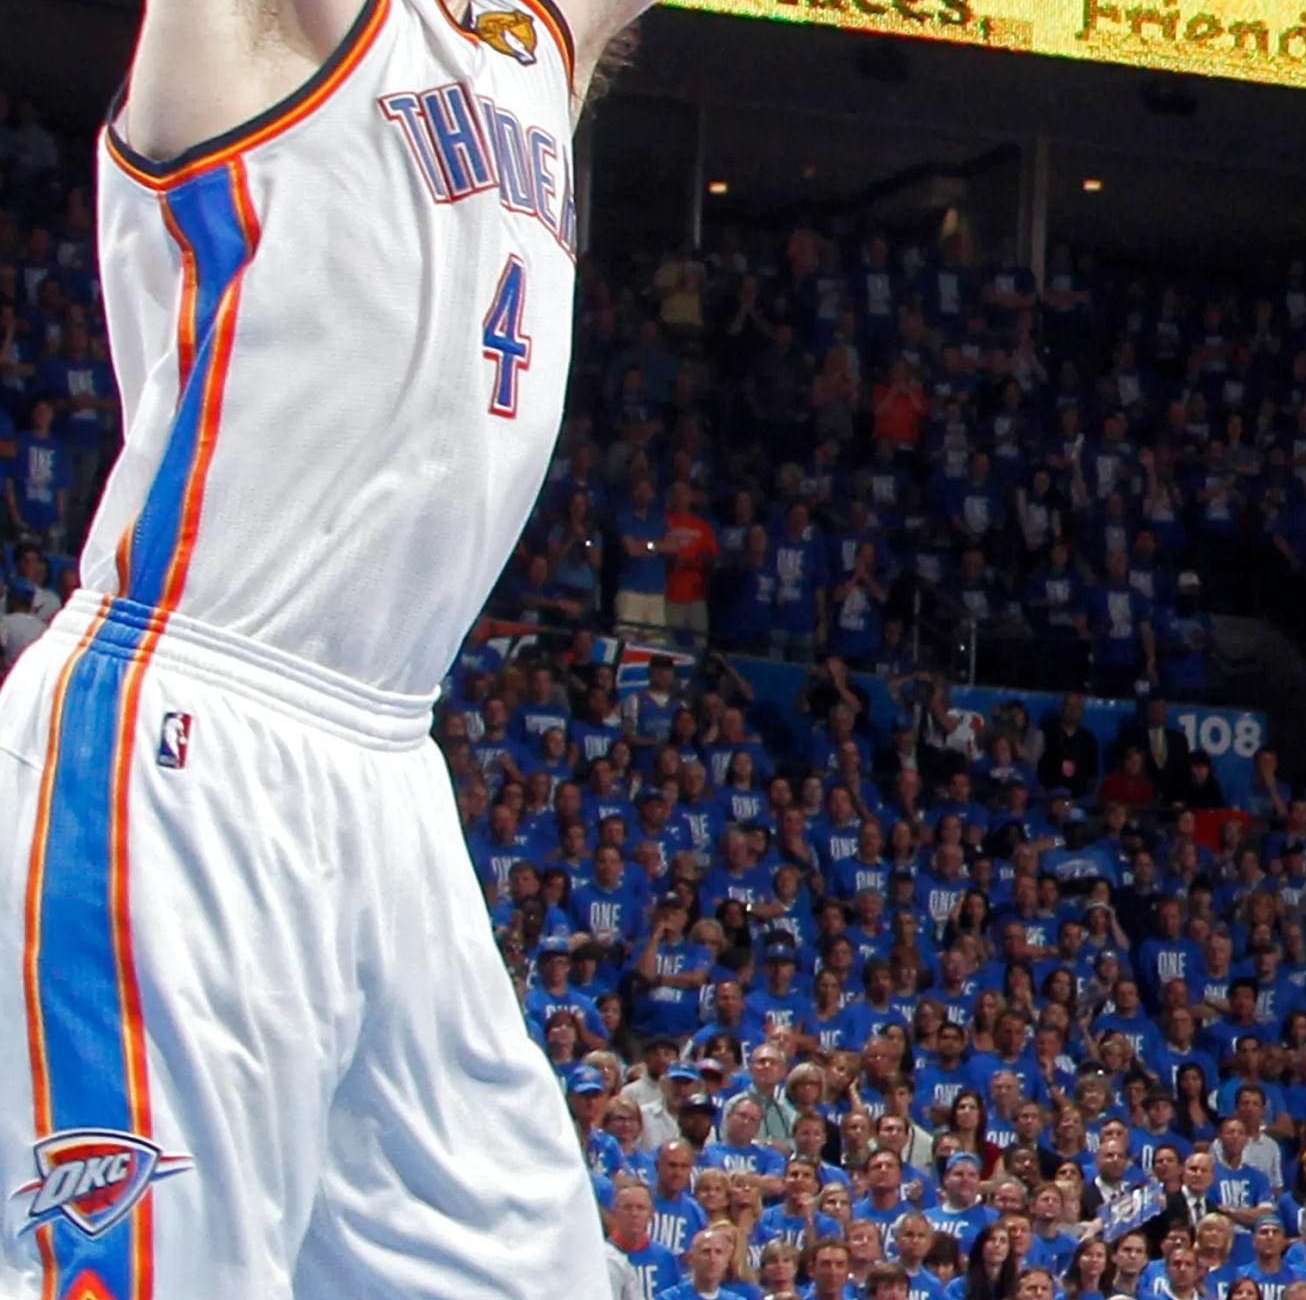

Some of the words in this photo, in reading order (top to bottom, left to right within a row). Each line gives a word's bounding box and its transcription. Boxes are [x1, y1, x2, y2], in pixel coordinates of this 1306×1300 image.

[483, 253, 532, 418] 4
[1179, 714, 1262, 756] 108
[590, 902, 620, 931] ONE
[1157, 951, 1186, 977] ONE
[30, 1152, 132, 1217] OKC
[1219, 1180, 1250, 1207] ONE
[648, 1212, 686, 1252] ONE
